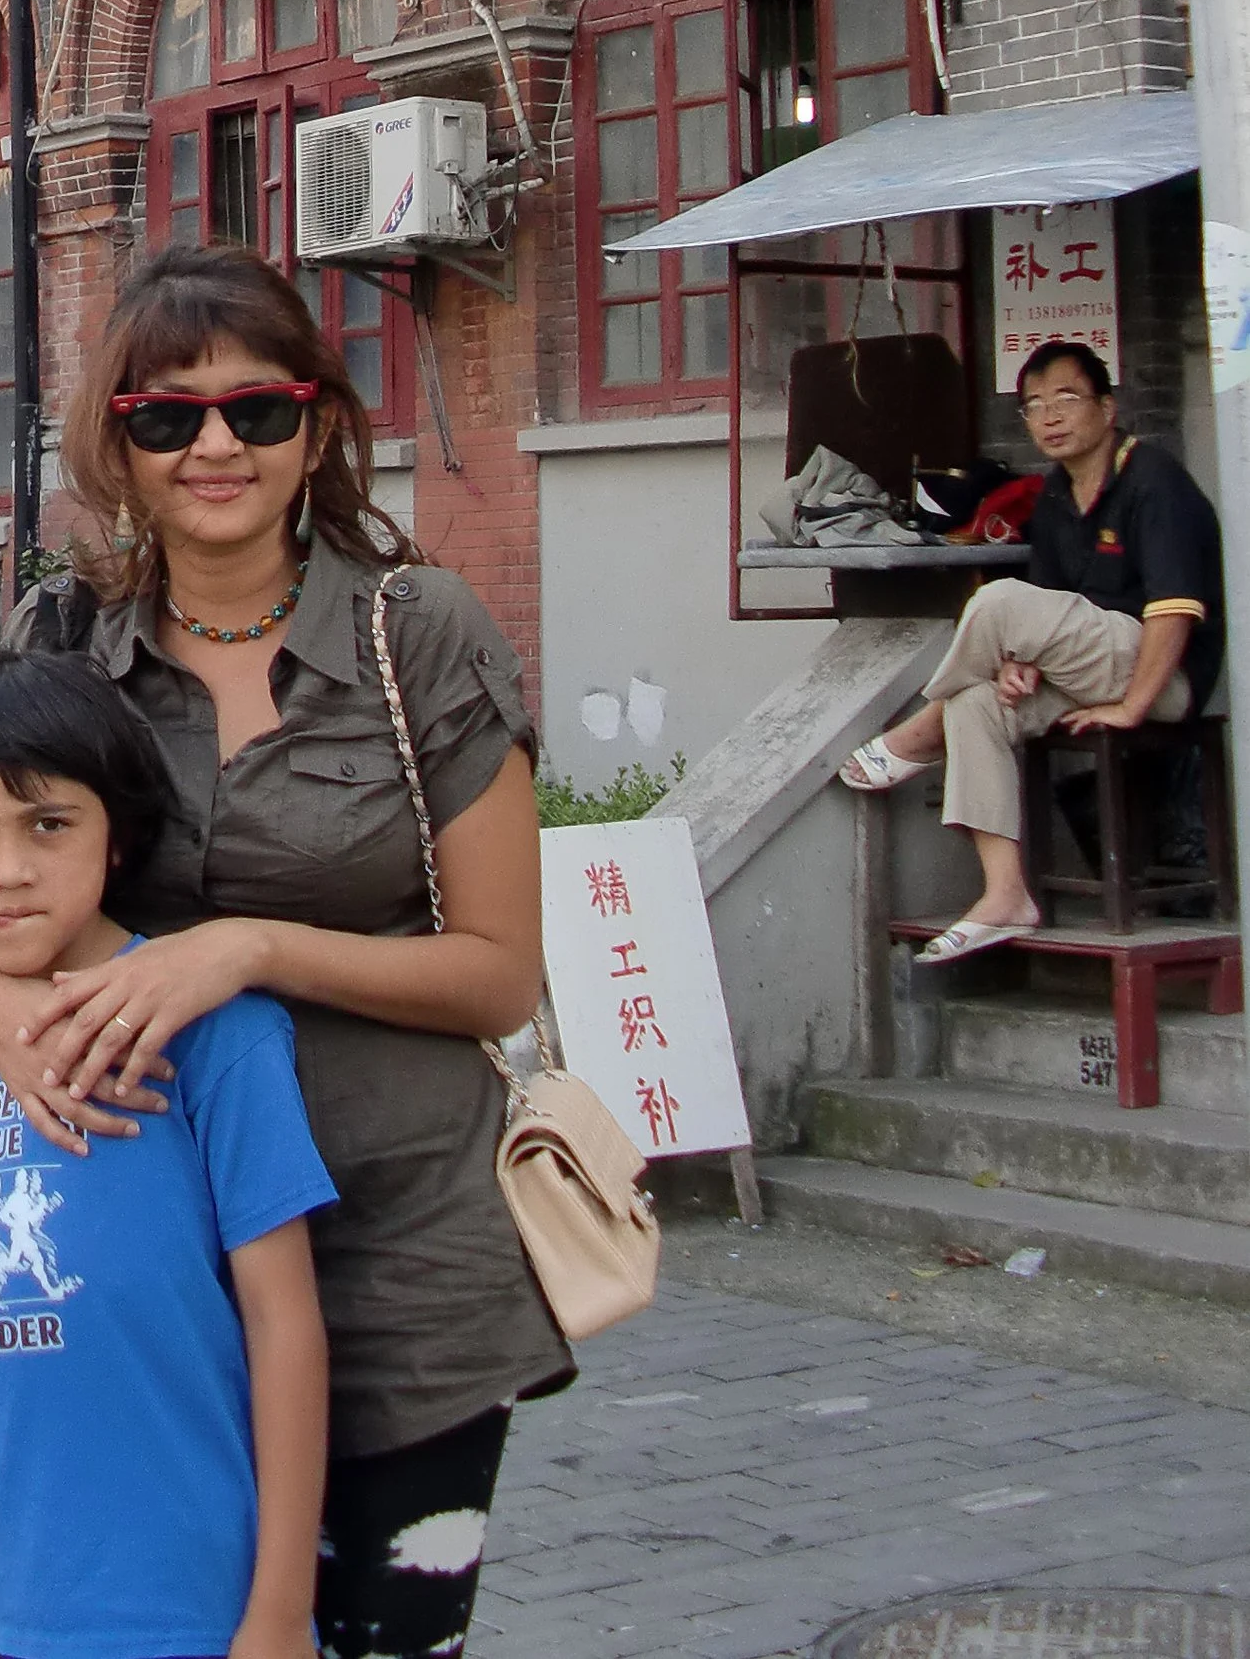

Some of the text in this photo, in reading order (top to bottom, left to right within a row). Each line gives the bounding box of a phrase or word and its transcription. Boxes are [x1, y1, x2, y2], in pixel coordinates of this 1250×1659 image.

[385, 117, 413, 133] GREE
[583, 859, 681, 1147] 精工织补
